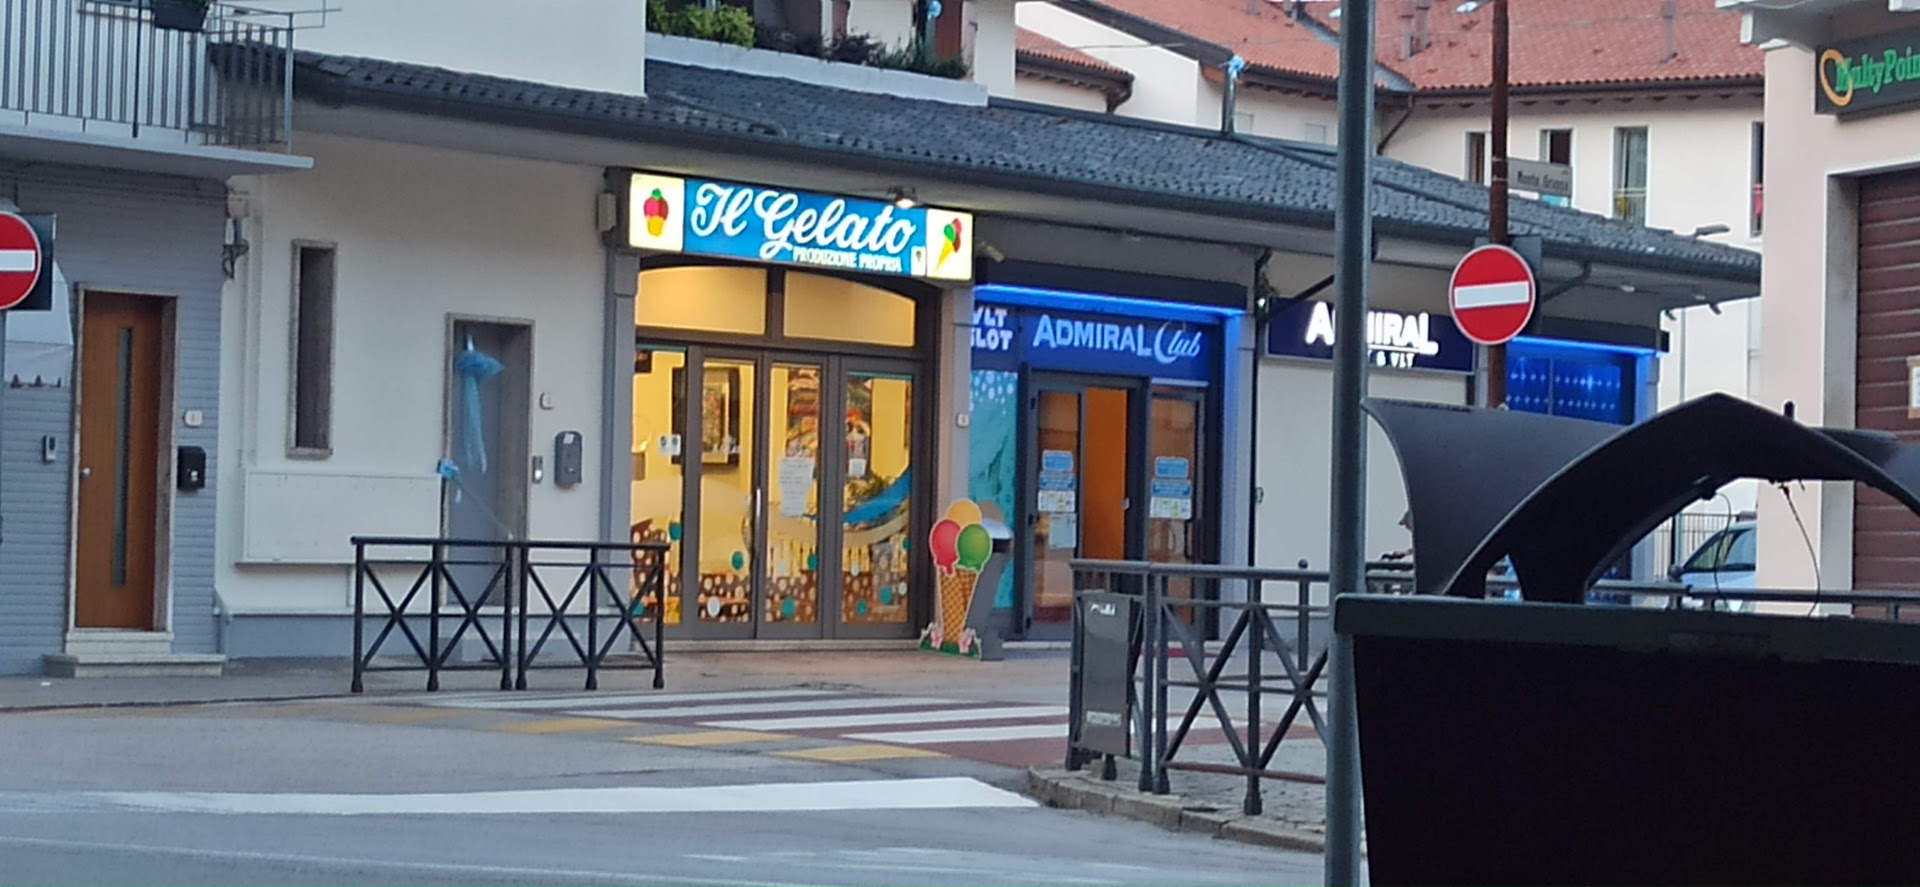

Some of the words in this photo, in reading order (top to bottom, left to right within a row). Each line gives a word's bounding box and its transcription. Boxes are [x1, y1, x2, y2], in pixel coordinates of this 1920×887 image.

[690, 182, 753, 237] Il
[753, 189, 916, 260] Gelato
[793, 246, 857, 268] PRODUZIONE
[859, 253, 902, 272] PROPRIA
[1033, 314, 1154, 357] ADMIRAL
[1154, 320, 1202, 364] Club
[1305, 301, 1439, 355] AIRAL
[1390, 352, 1416, 368] VLT
